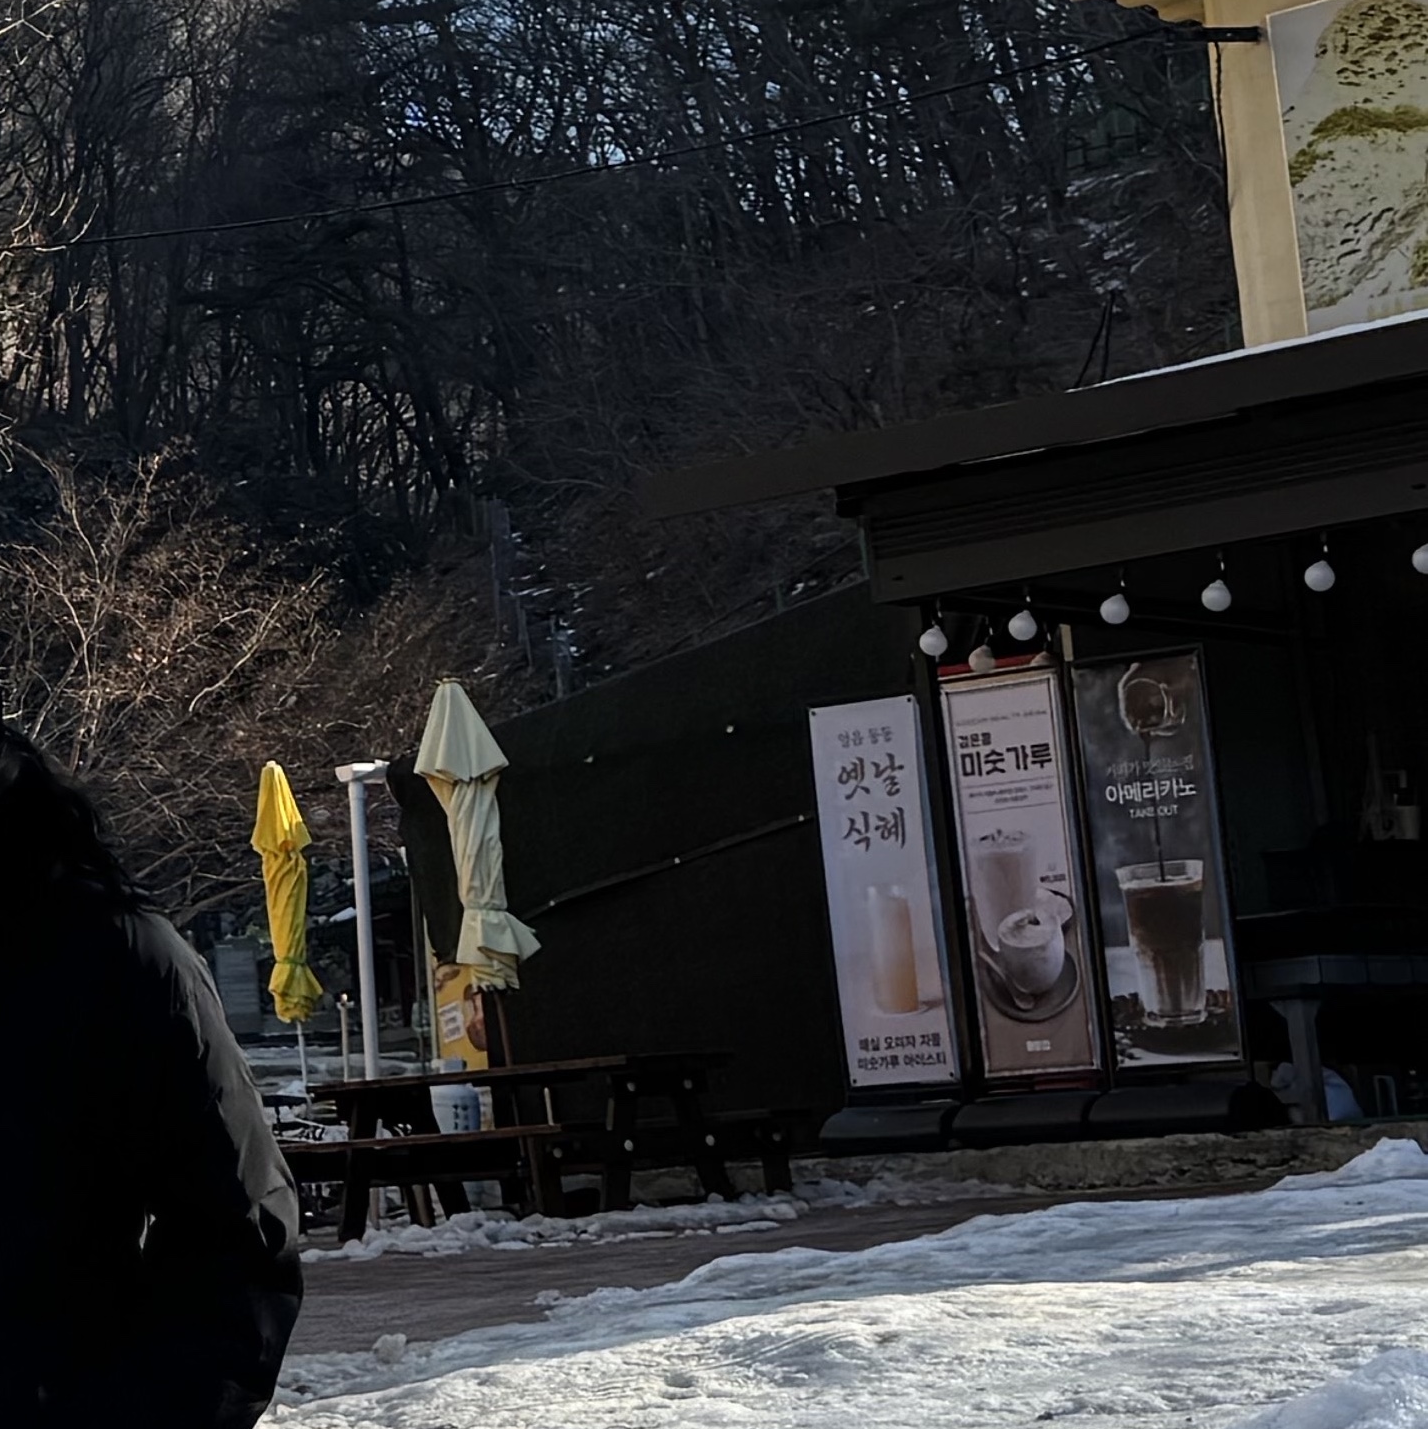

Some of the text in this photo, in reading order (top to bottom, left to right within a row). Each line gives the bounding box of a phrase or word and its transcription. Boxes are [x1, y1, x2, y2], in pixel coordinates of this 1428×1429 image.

[837, 752, 906, 801] 옛날
[959, 742, 1053, 778] 미숫가루
[1104, 775, 1198, 805] 아메리카노
[841, 806, 906, 853] 식혜
[1128, 804, 1179, 820] TAKE OUT
